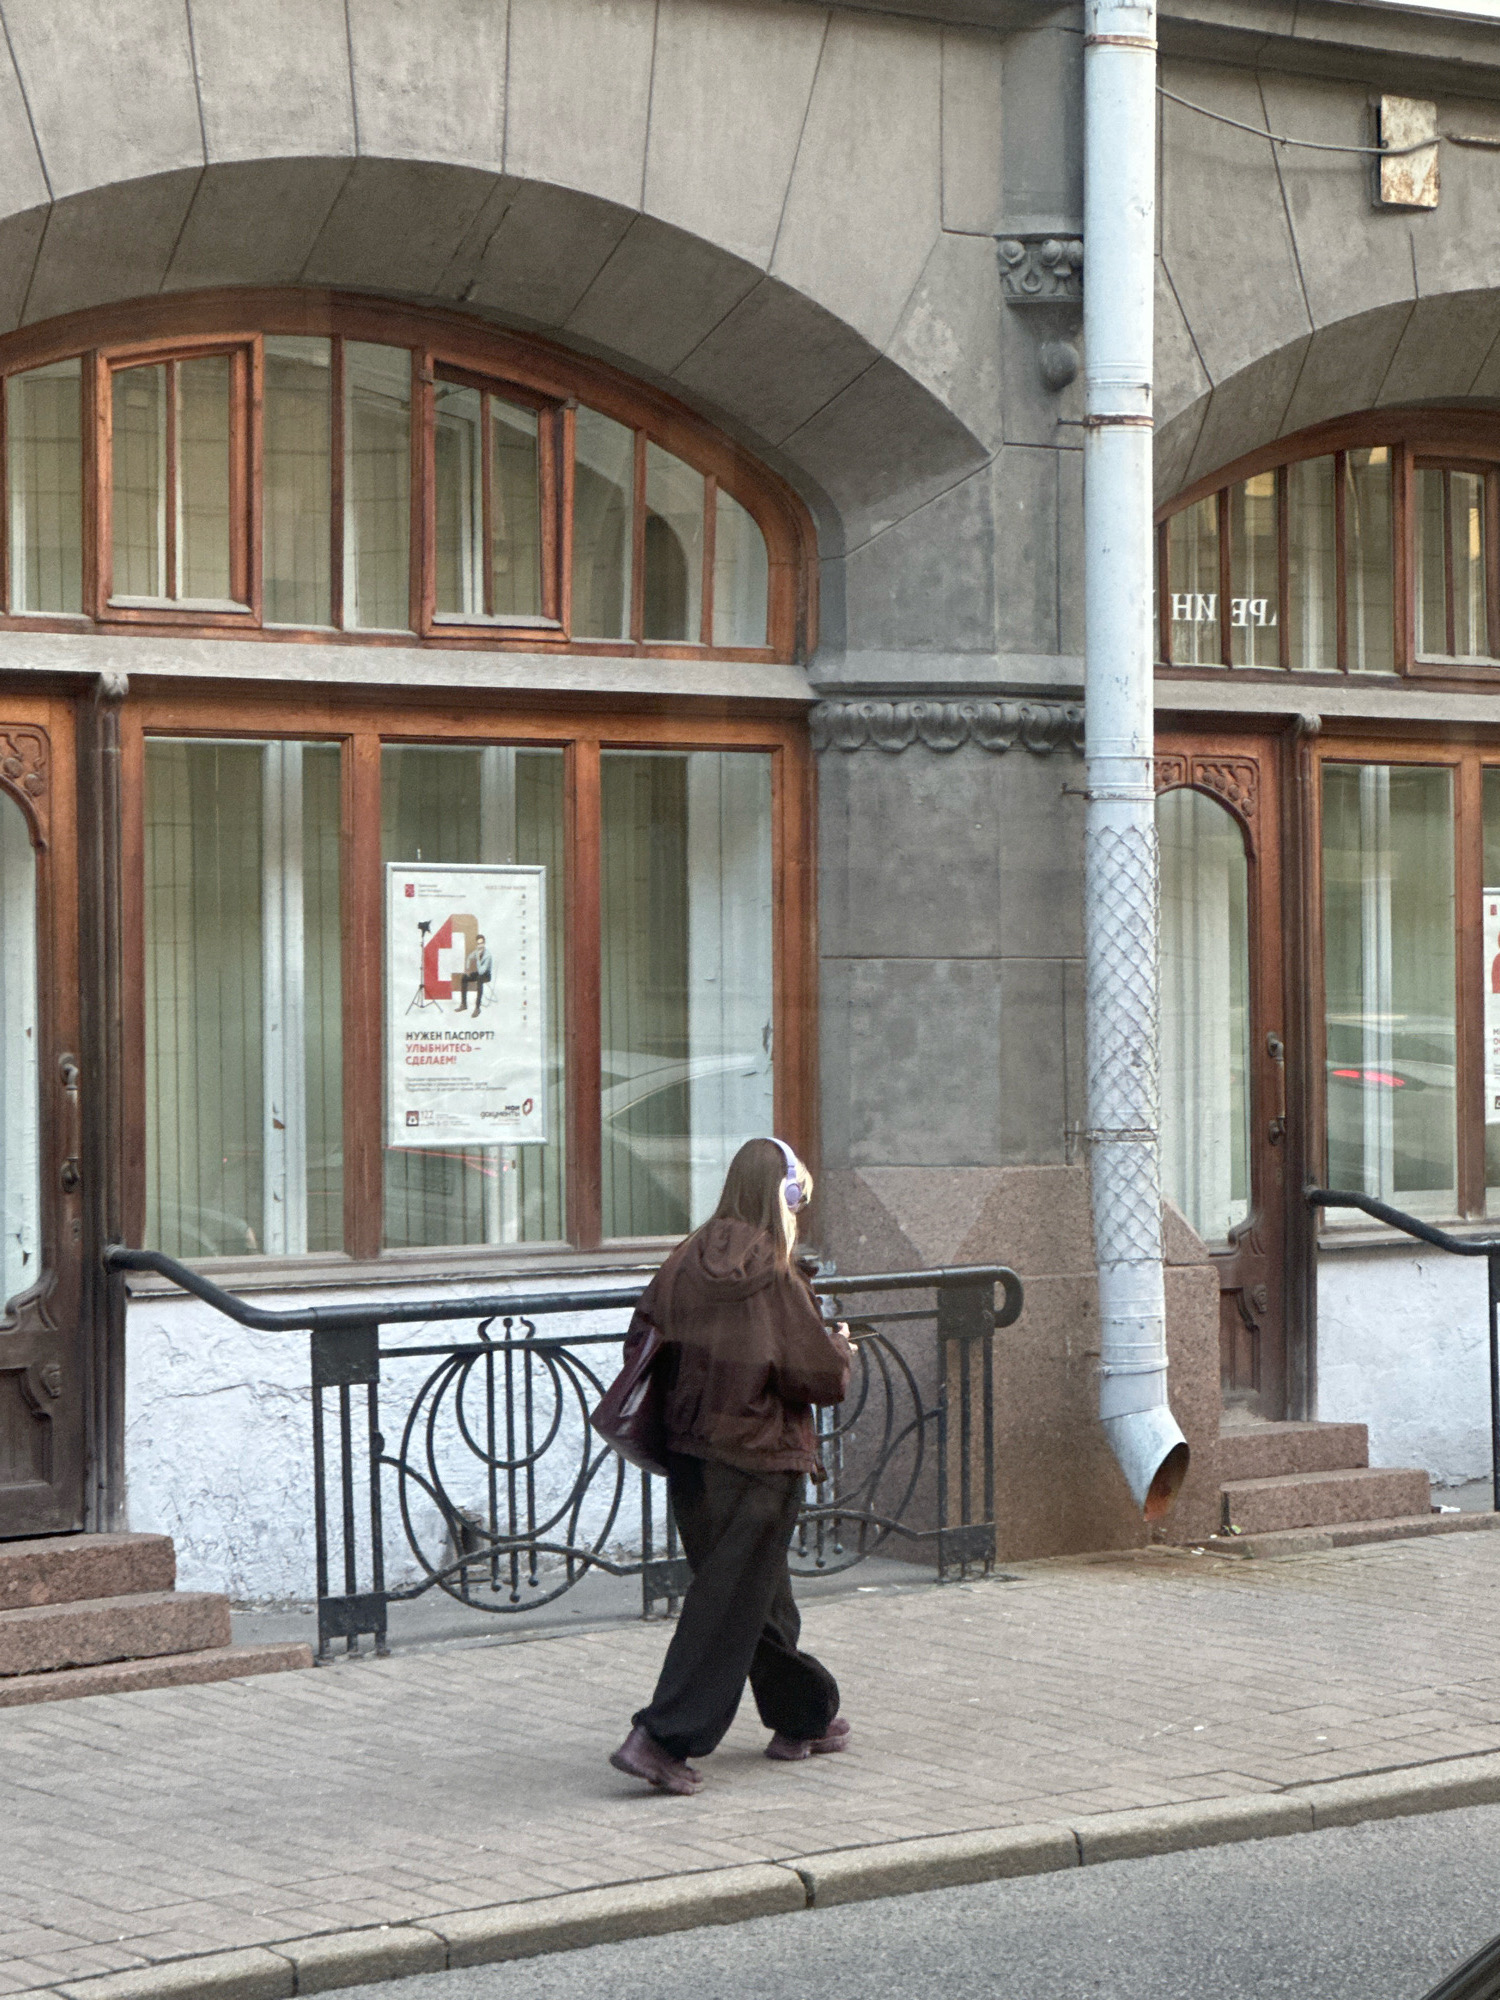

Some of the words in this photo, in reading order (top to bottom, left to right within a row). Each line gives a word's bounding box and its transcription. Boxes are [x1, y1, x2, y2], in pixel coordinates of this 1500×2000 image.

[406, 1031, 442, 1041] НУЖЕН
[444, 1031, 495, 1041] ПАСПОРТ?
[406, 1043, 472, 1053] УЛЫБНИТЕСЬ
[405, 1055, 457, 1065] СДЕЛАЕМ!
